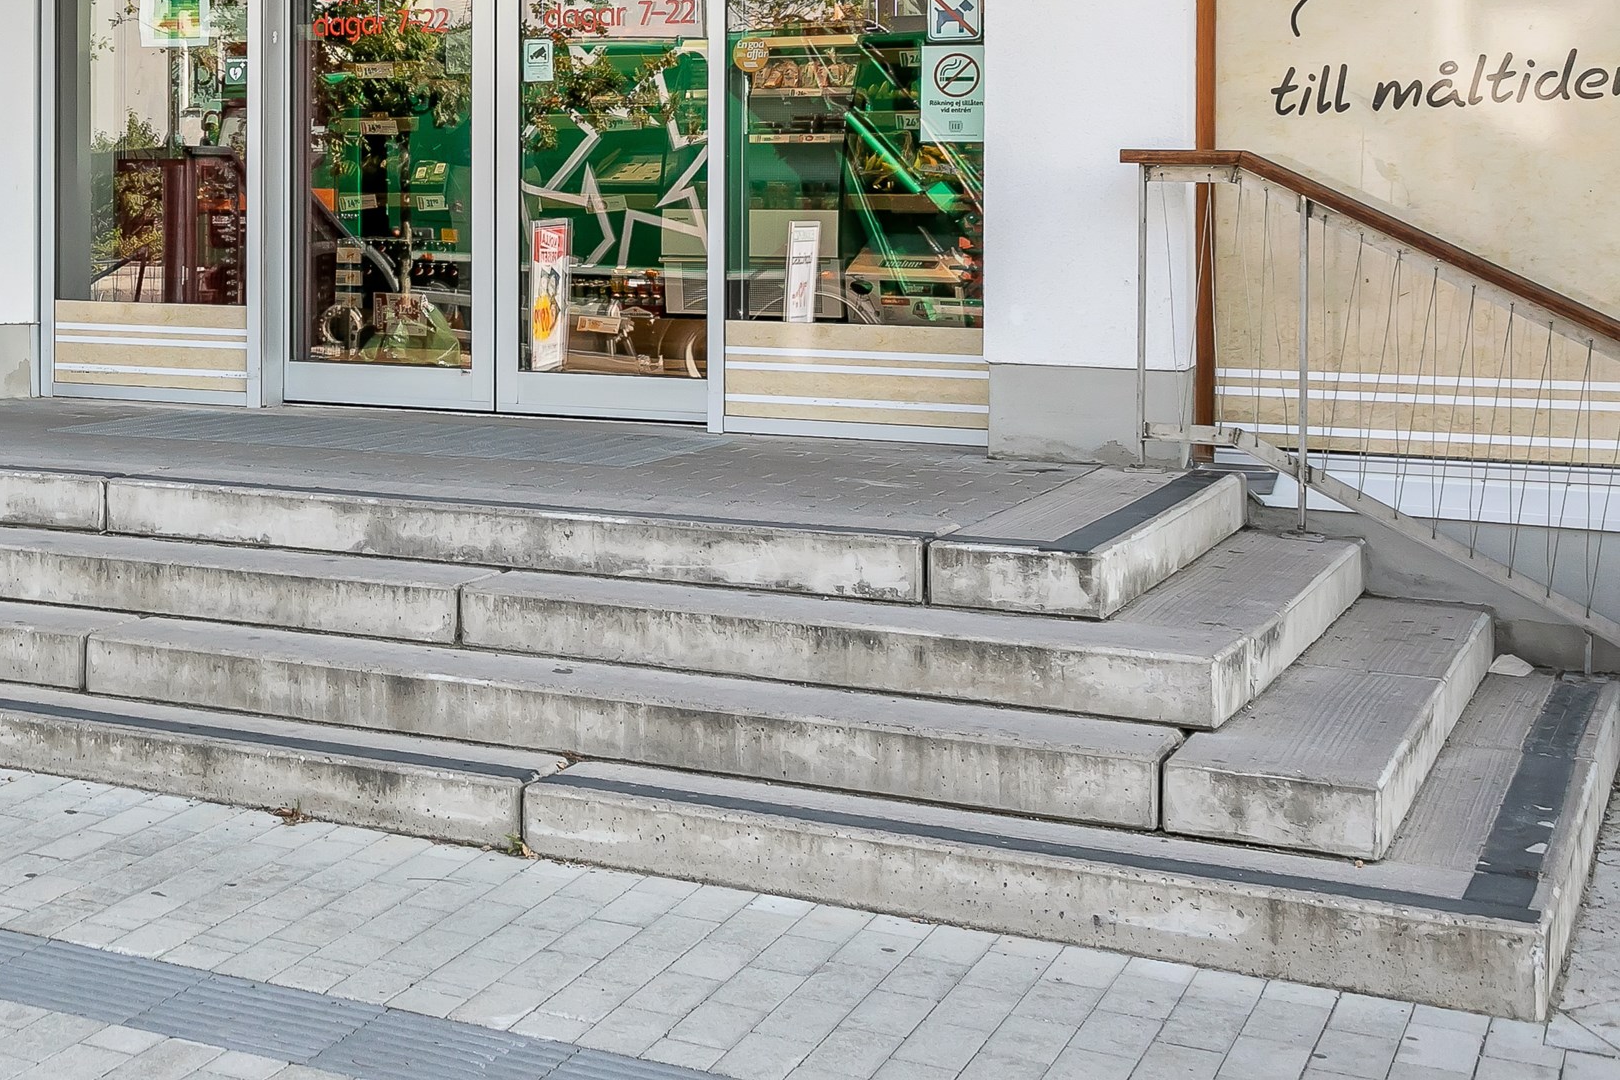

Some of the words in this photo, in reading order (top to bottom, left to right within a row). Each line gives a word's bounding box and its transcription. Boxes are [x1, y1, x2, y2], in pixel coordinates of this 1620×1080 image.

[312, 11, 386, 45] dagar
[543, 3, 627, 33] dagar
[1270, 63, 1351, 116] till
[1371, 48, 1620, 112] måltide
[929, 99, 955, 108] Rökning
[962, 98, 984, 106] tillåten
